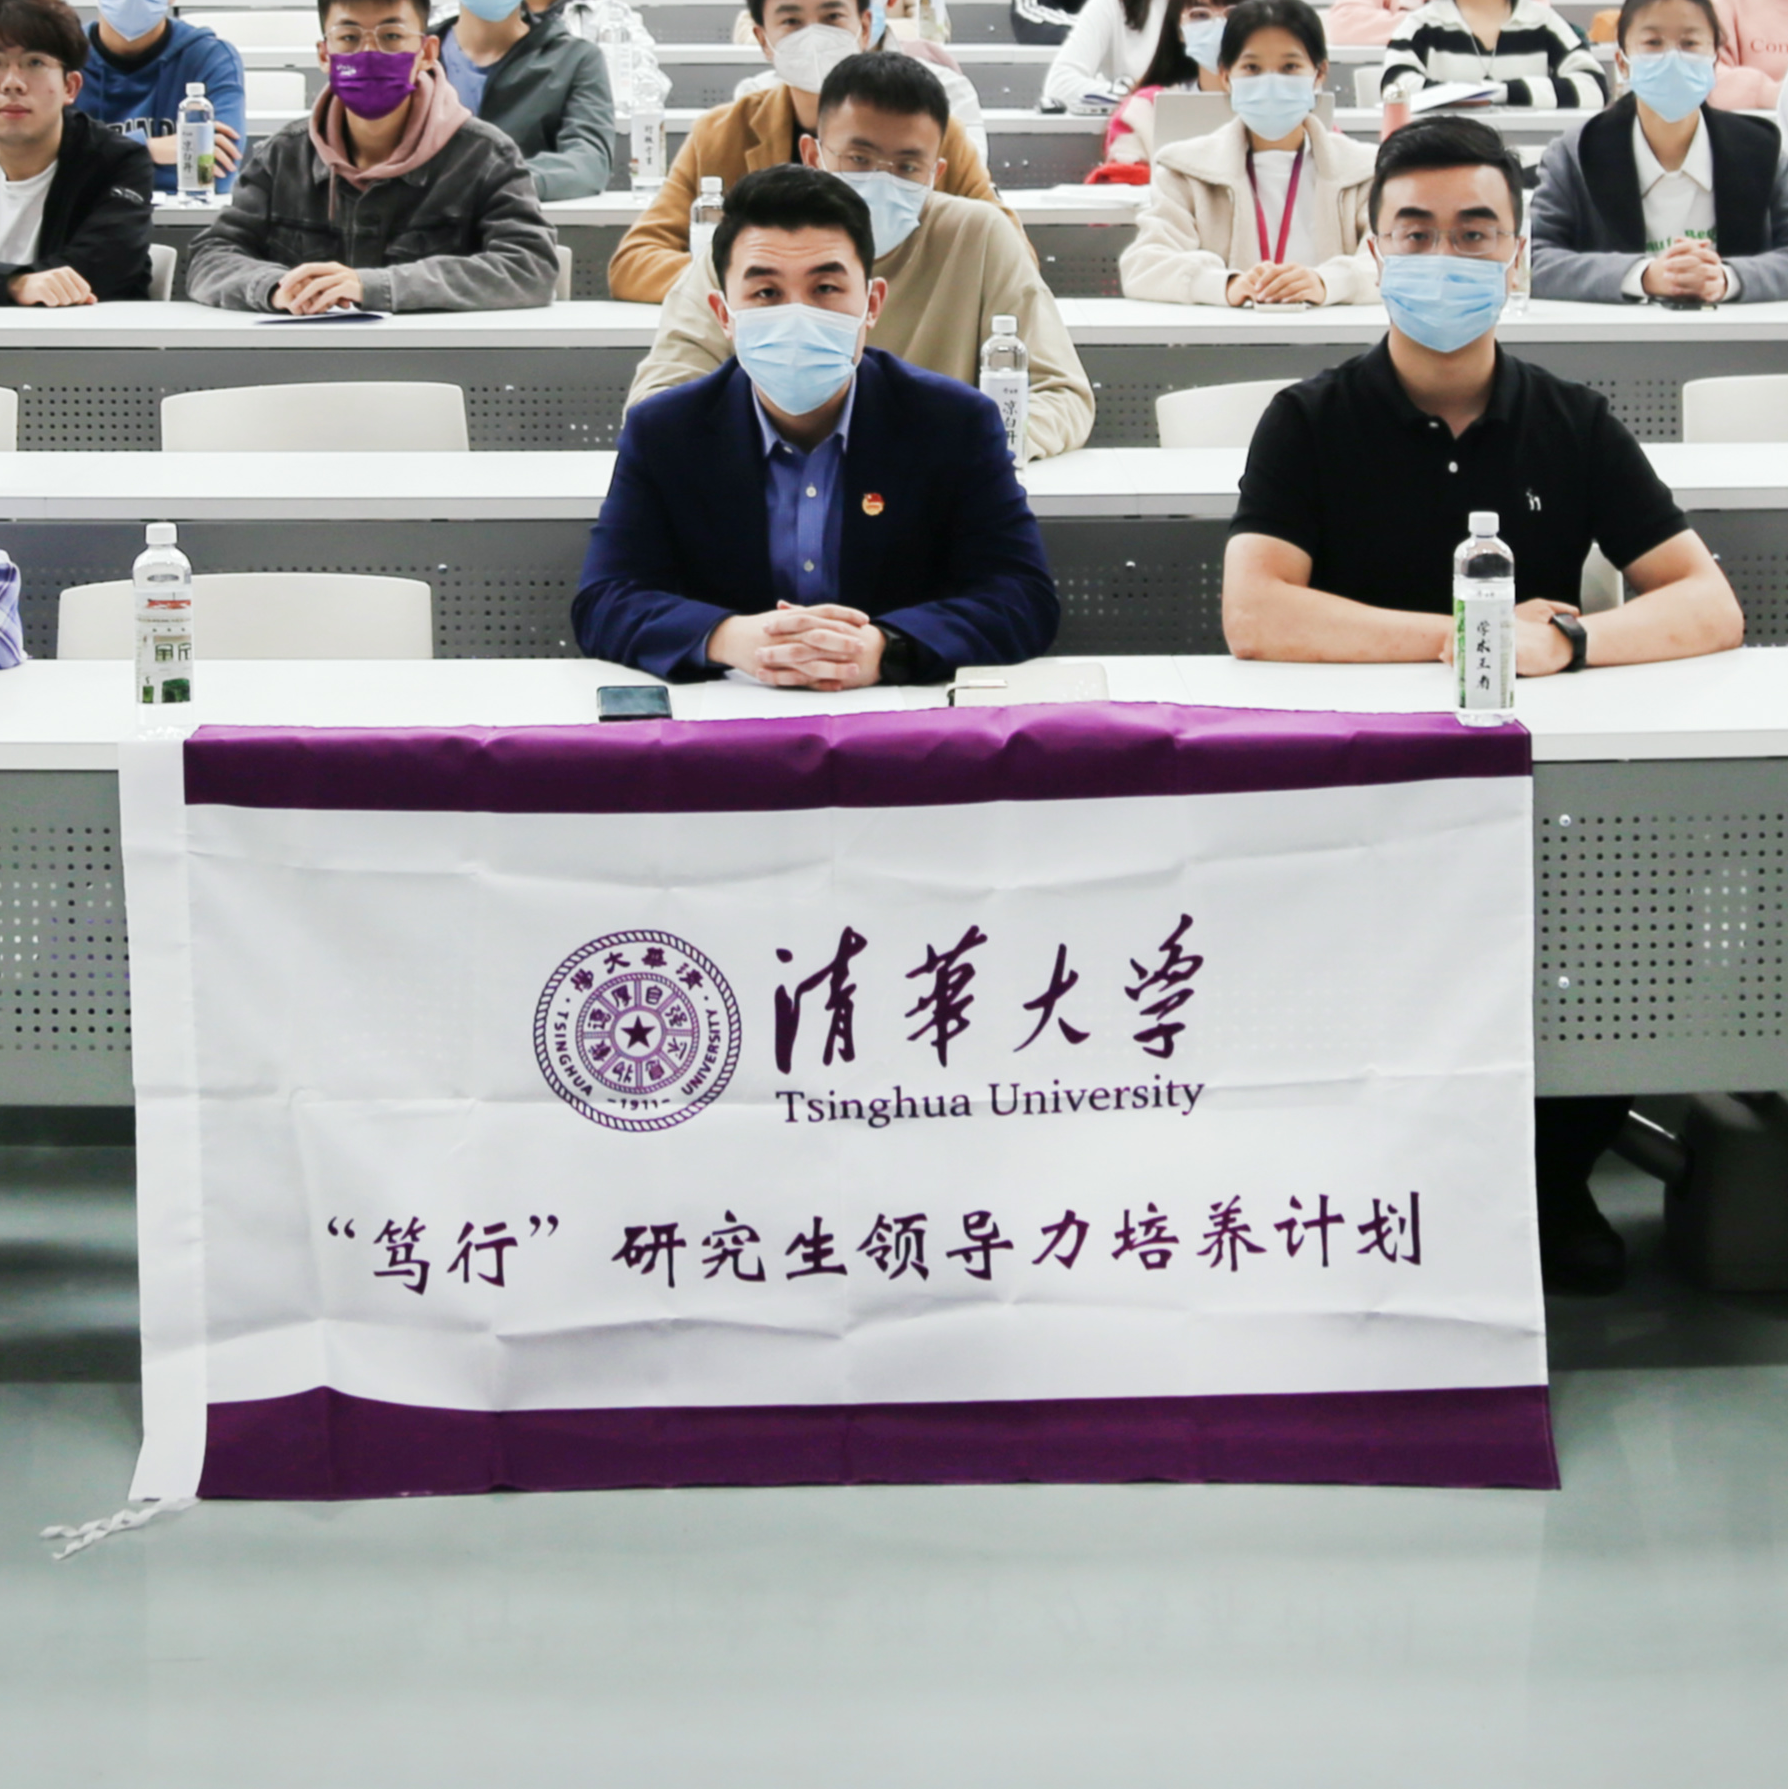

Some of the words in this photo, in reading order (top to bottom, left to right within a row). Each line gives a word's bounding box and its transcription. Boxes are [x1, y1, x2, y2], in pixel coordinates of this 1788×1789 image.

[554, 1011, 594, 1097] TSINGHUA
[681, 1009, 721, 1096] UNIVERSITY
[775, 1085, 972, 1129] Tsinghua
[988, 1074, 1206, 1116] University
[611, 1191, 1422, 1289] 研究生领导力培养计划
